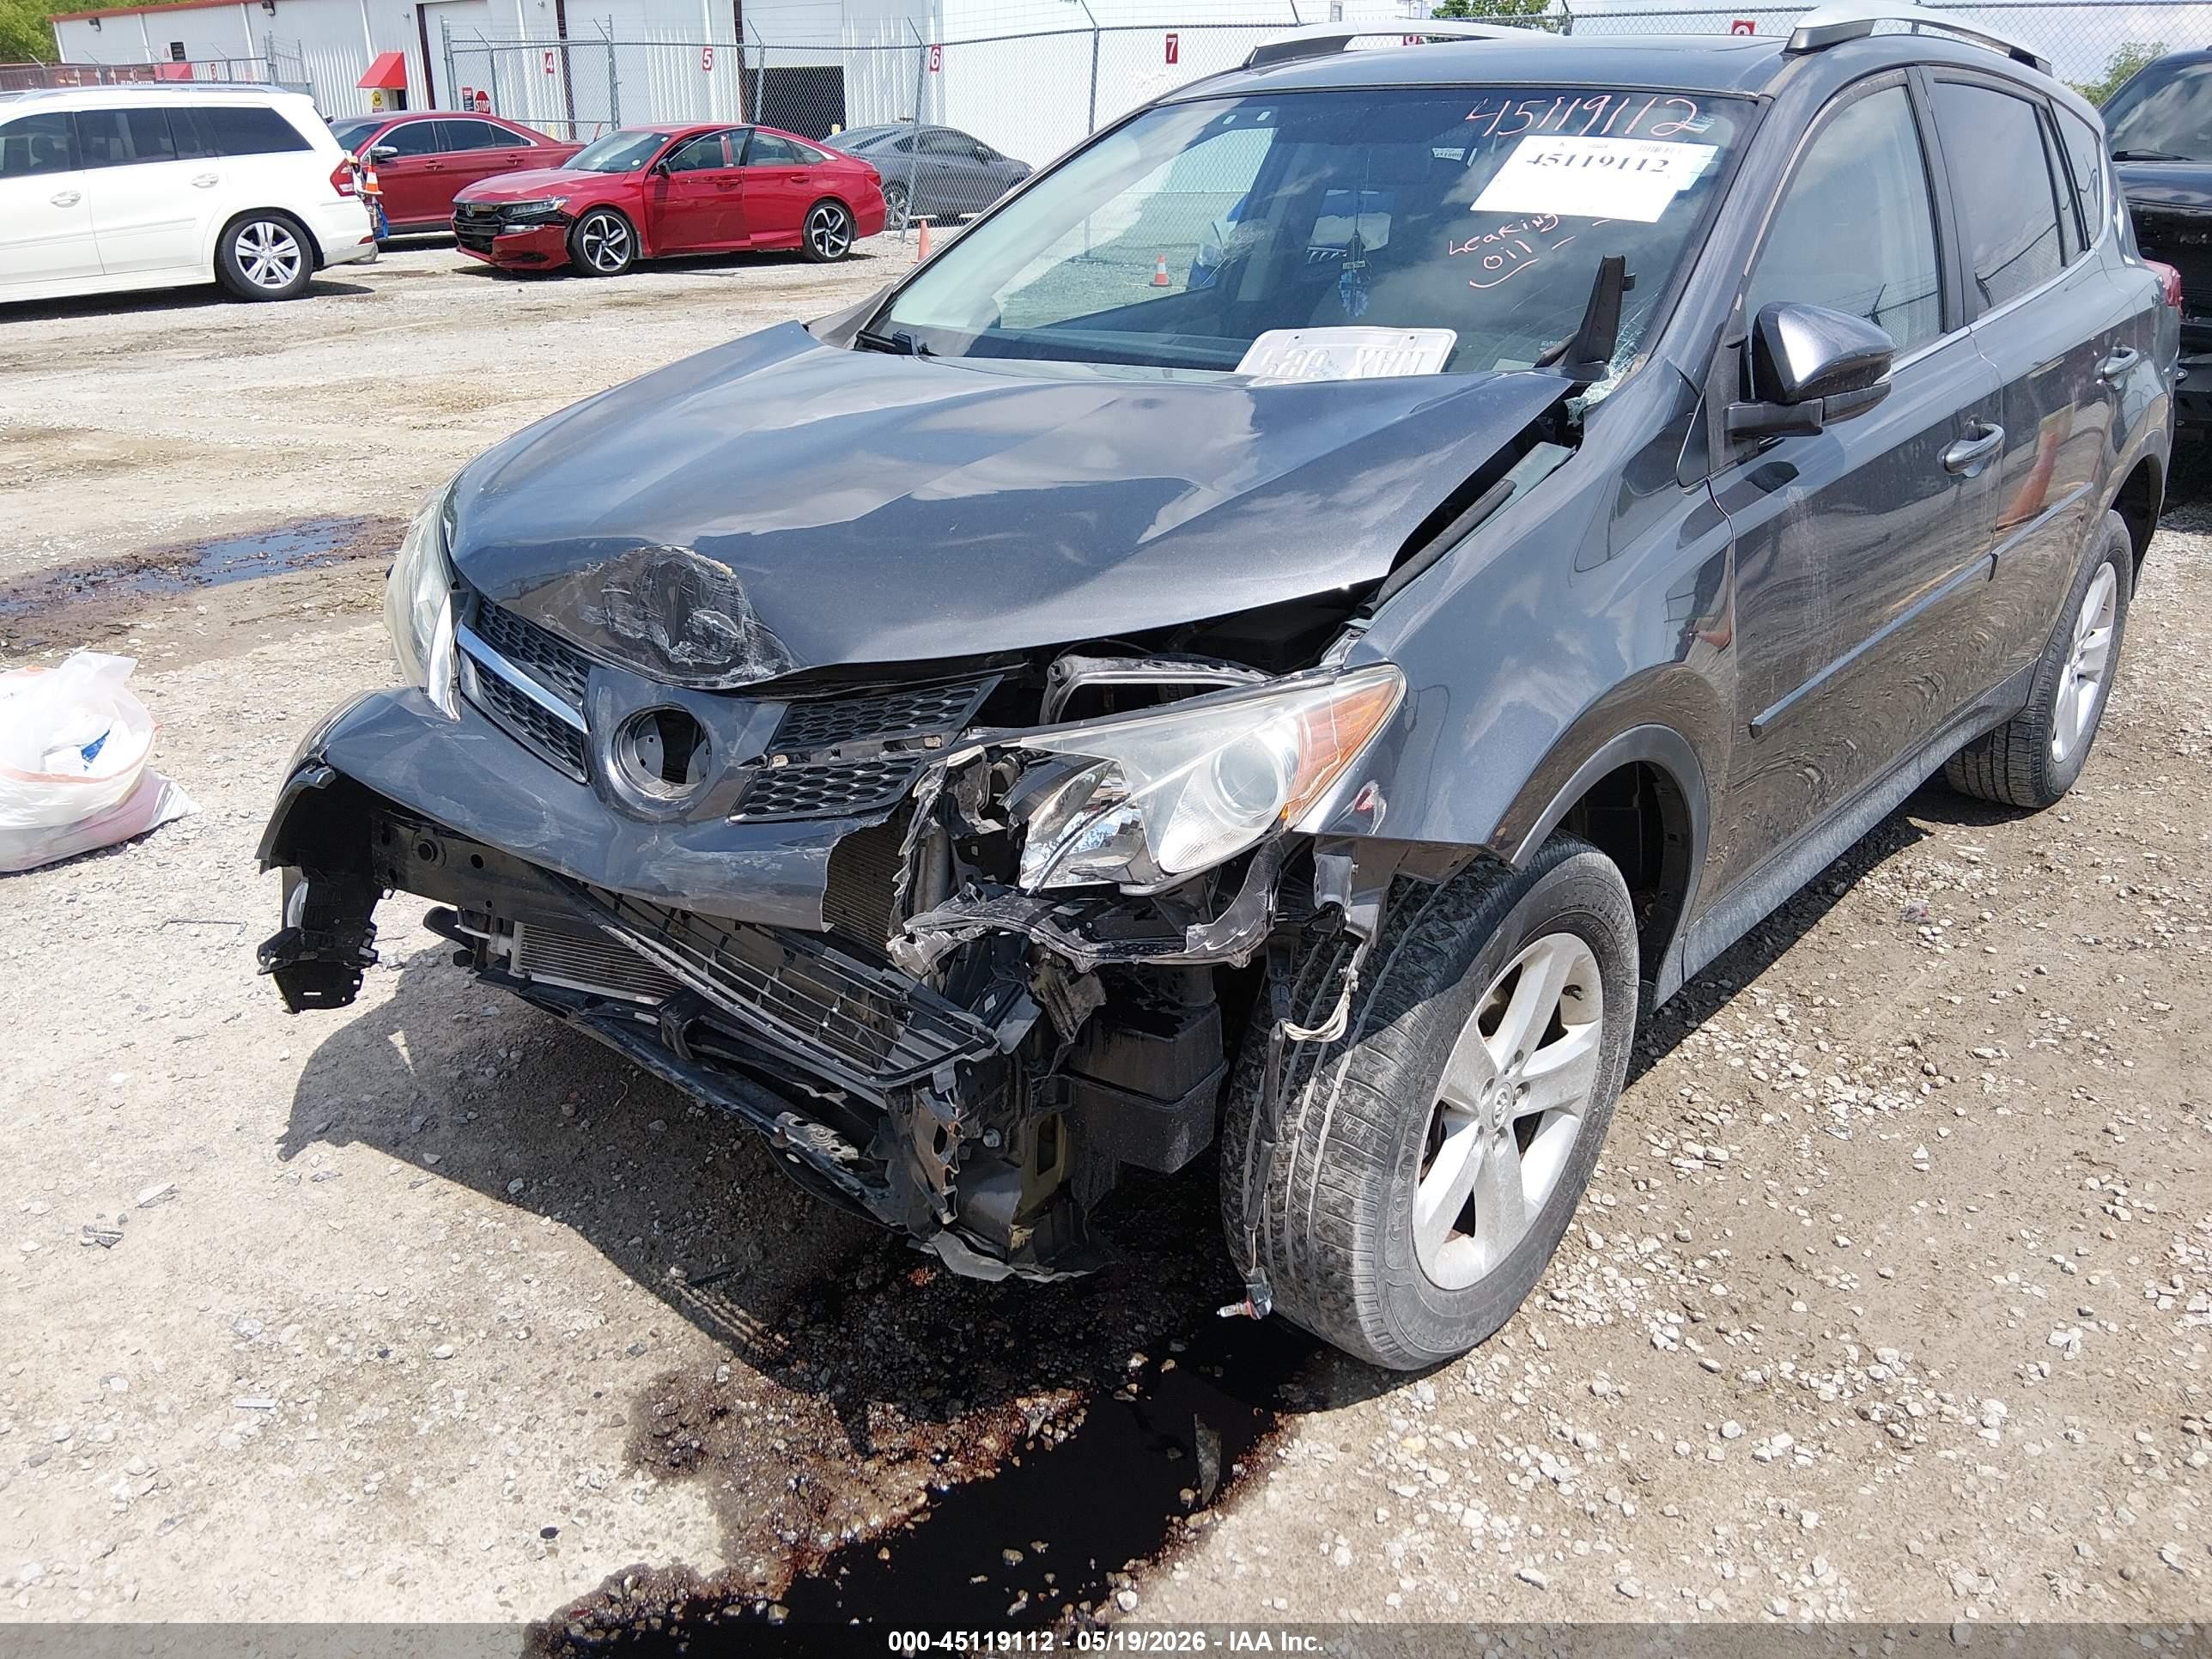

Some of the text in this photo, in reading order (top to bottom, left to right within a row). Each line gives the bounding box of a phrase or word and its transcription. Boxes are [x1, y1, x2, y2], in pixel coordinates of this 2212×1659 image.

[931, 48, 941, 69] 6
[1167, 37, 1177, 61] 7
[545, 54, 555, 72] 4
[702, 51, 713, 69] 5
[475, 100, 490, 112] STOP
[1465, 94, 1705, 137] 45119112
[1526, 153, 1670, 173] 45119112
